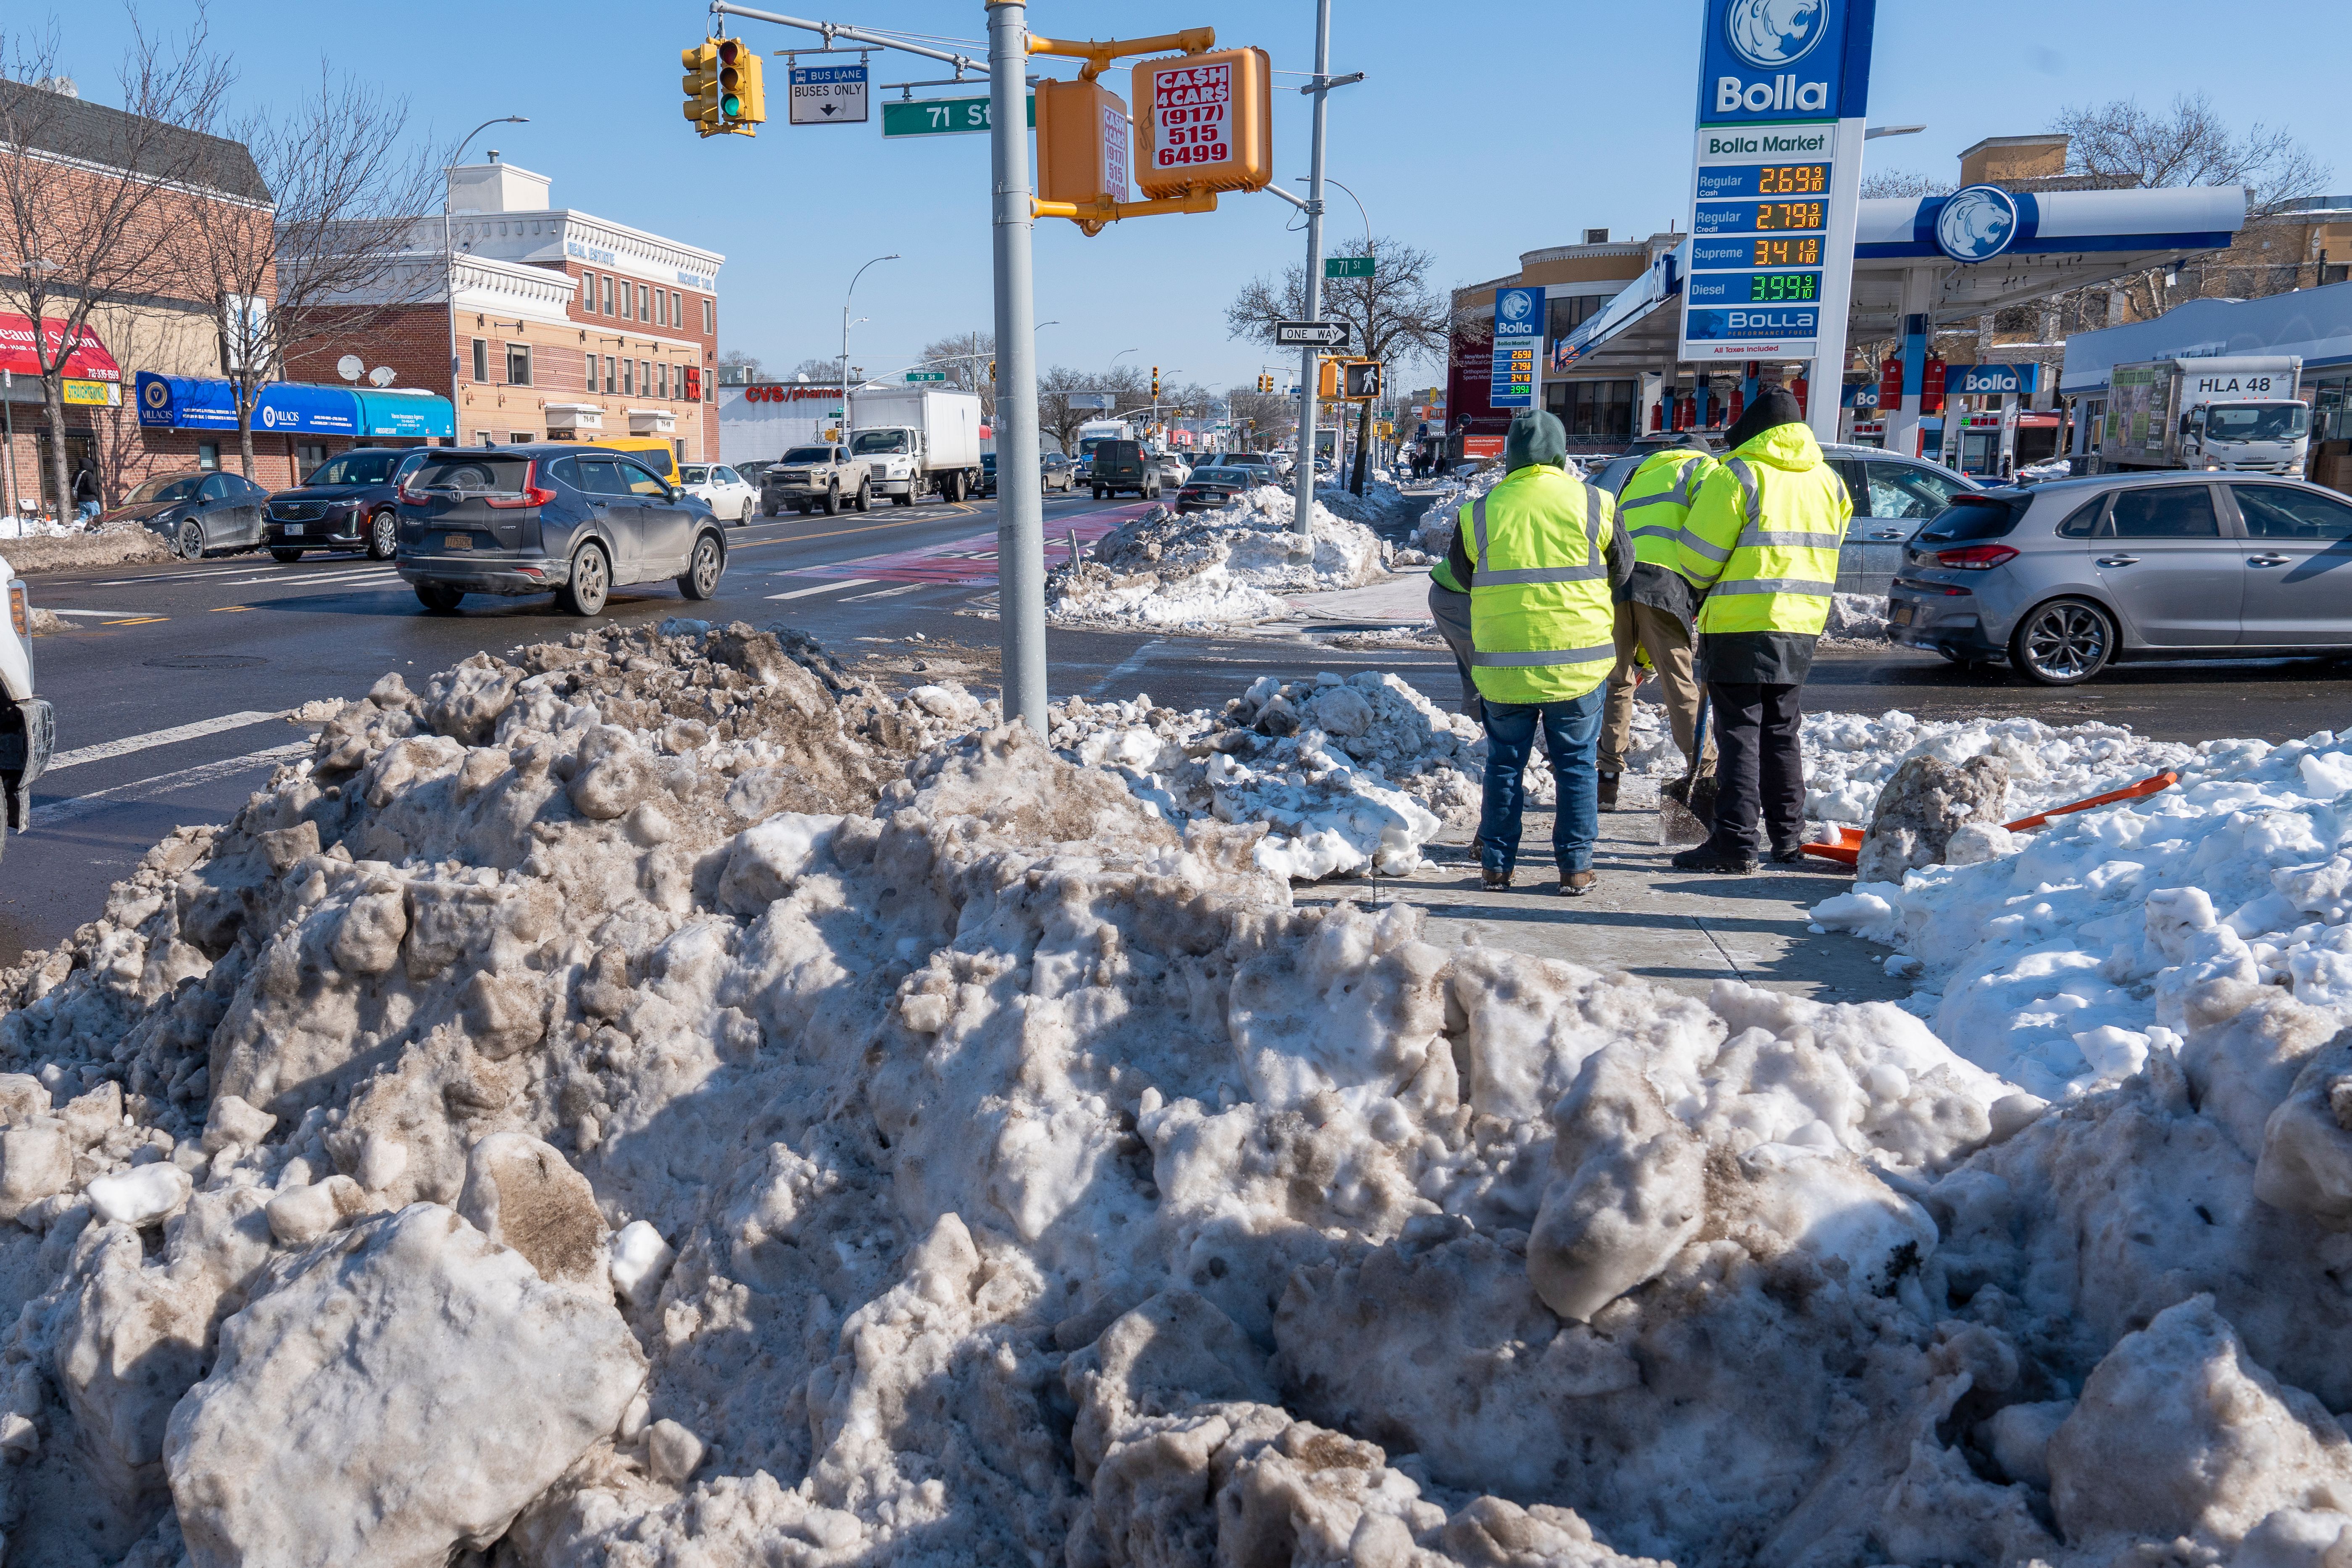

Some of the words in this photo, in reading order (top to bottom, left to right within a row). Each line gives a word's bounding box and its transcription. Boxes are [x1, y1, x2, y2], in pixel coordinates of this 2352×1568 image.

[811, 71, 830, 80] BUS
[835, 70, 861, 79] LANE
[1158, 67, 1227, 89] CA$H
[795, 85, 829, 97] BUSES
[835, 84, 862, 95] ONLY
[1158, 92, 1168, 107] 4
[1171, 83, 1227, 105] CAR$
[1716, 74, 1828, 113] Bolla
[927, 106, 950, 127] 71
[968, 103, 991, 126] St
[1105, 111, 1124, 133] CA$H
[1162, 104, 1223, 126] (917)
[1106, 127, 1109, 141] 4
[1169, 124, 1218, 145] 515
[1709, 137, 1757, 154] Bolla
[1762, 134, 1825, 152] Market
[1107, 144, 1124, 166] (917)
[1159, 143, 1227, 166] 6499
[1109, 162, 1123, 184] 515
[1700, 175, 1742, 189] Regular
[1759, 167, 1810, 193] 2.69
[1106, 179, 1125, 203] 6499
[1697, 210, 1741, 224] Regular
[1757, 203, 1807, 229] 2.79
[567, 242, 587, 259] REAL
[589, 247, 615, 266] ESTATE
[1694, 248, 1743, 260] Supreme
[1755, 240, 1804, 265] 3.41
[1338, 261, 1348, 275] 71
[1353, 260, 1361, 269] St
[677, 271, 700, 287] INCOME
[701, 277, 712, 291] TAX
[1692, 284, 1725, 295] Diesel
[1752, 276, 1801, 300] 3.99
[0, 329, 47, 343] eaut
[1287, 329, 1308, 339] ONE
[1318, 329, 1339, 339] WAY
[1499, 322, 1532, 334] Bolla
[87, 368, 119, 379] 718-335-1599
[687, 369, 700, 380] MTO
[1966, 374, 2017, 390] Bolla
[2114, 373, 2125, 384] JOIN
[2125, 372, 2136, 383] OUR
[2136, 371, 2153, 383] TEAM
[68, 385, 104, 401] STRAIGHTENING
[686, 382, 702, 399] TAX
[2199, 378, 2239, 392] HLA
[2246, 378, 2270, 391] 48
[745, 386, 843, 403] CVS/pharma
[142, 410, 173, 419] VILLACIS
[275, 411, 299, 422] VILLACIS
[2149, 423, 2160, 435] Your
